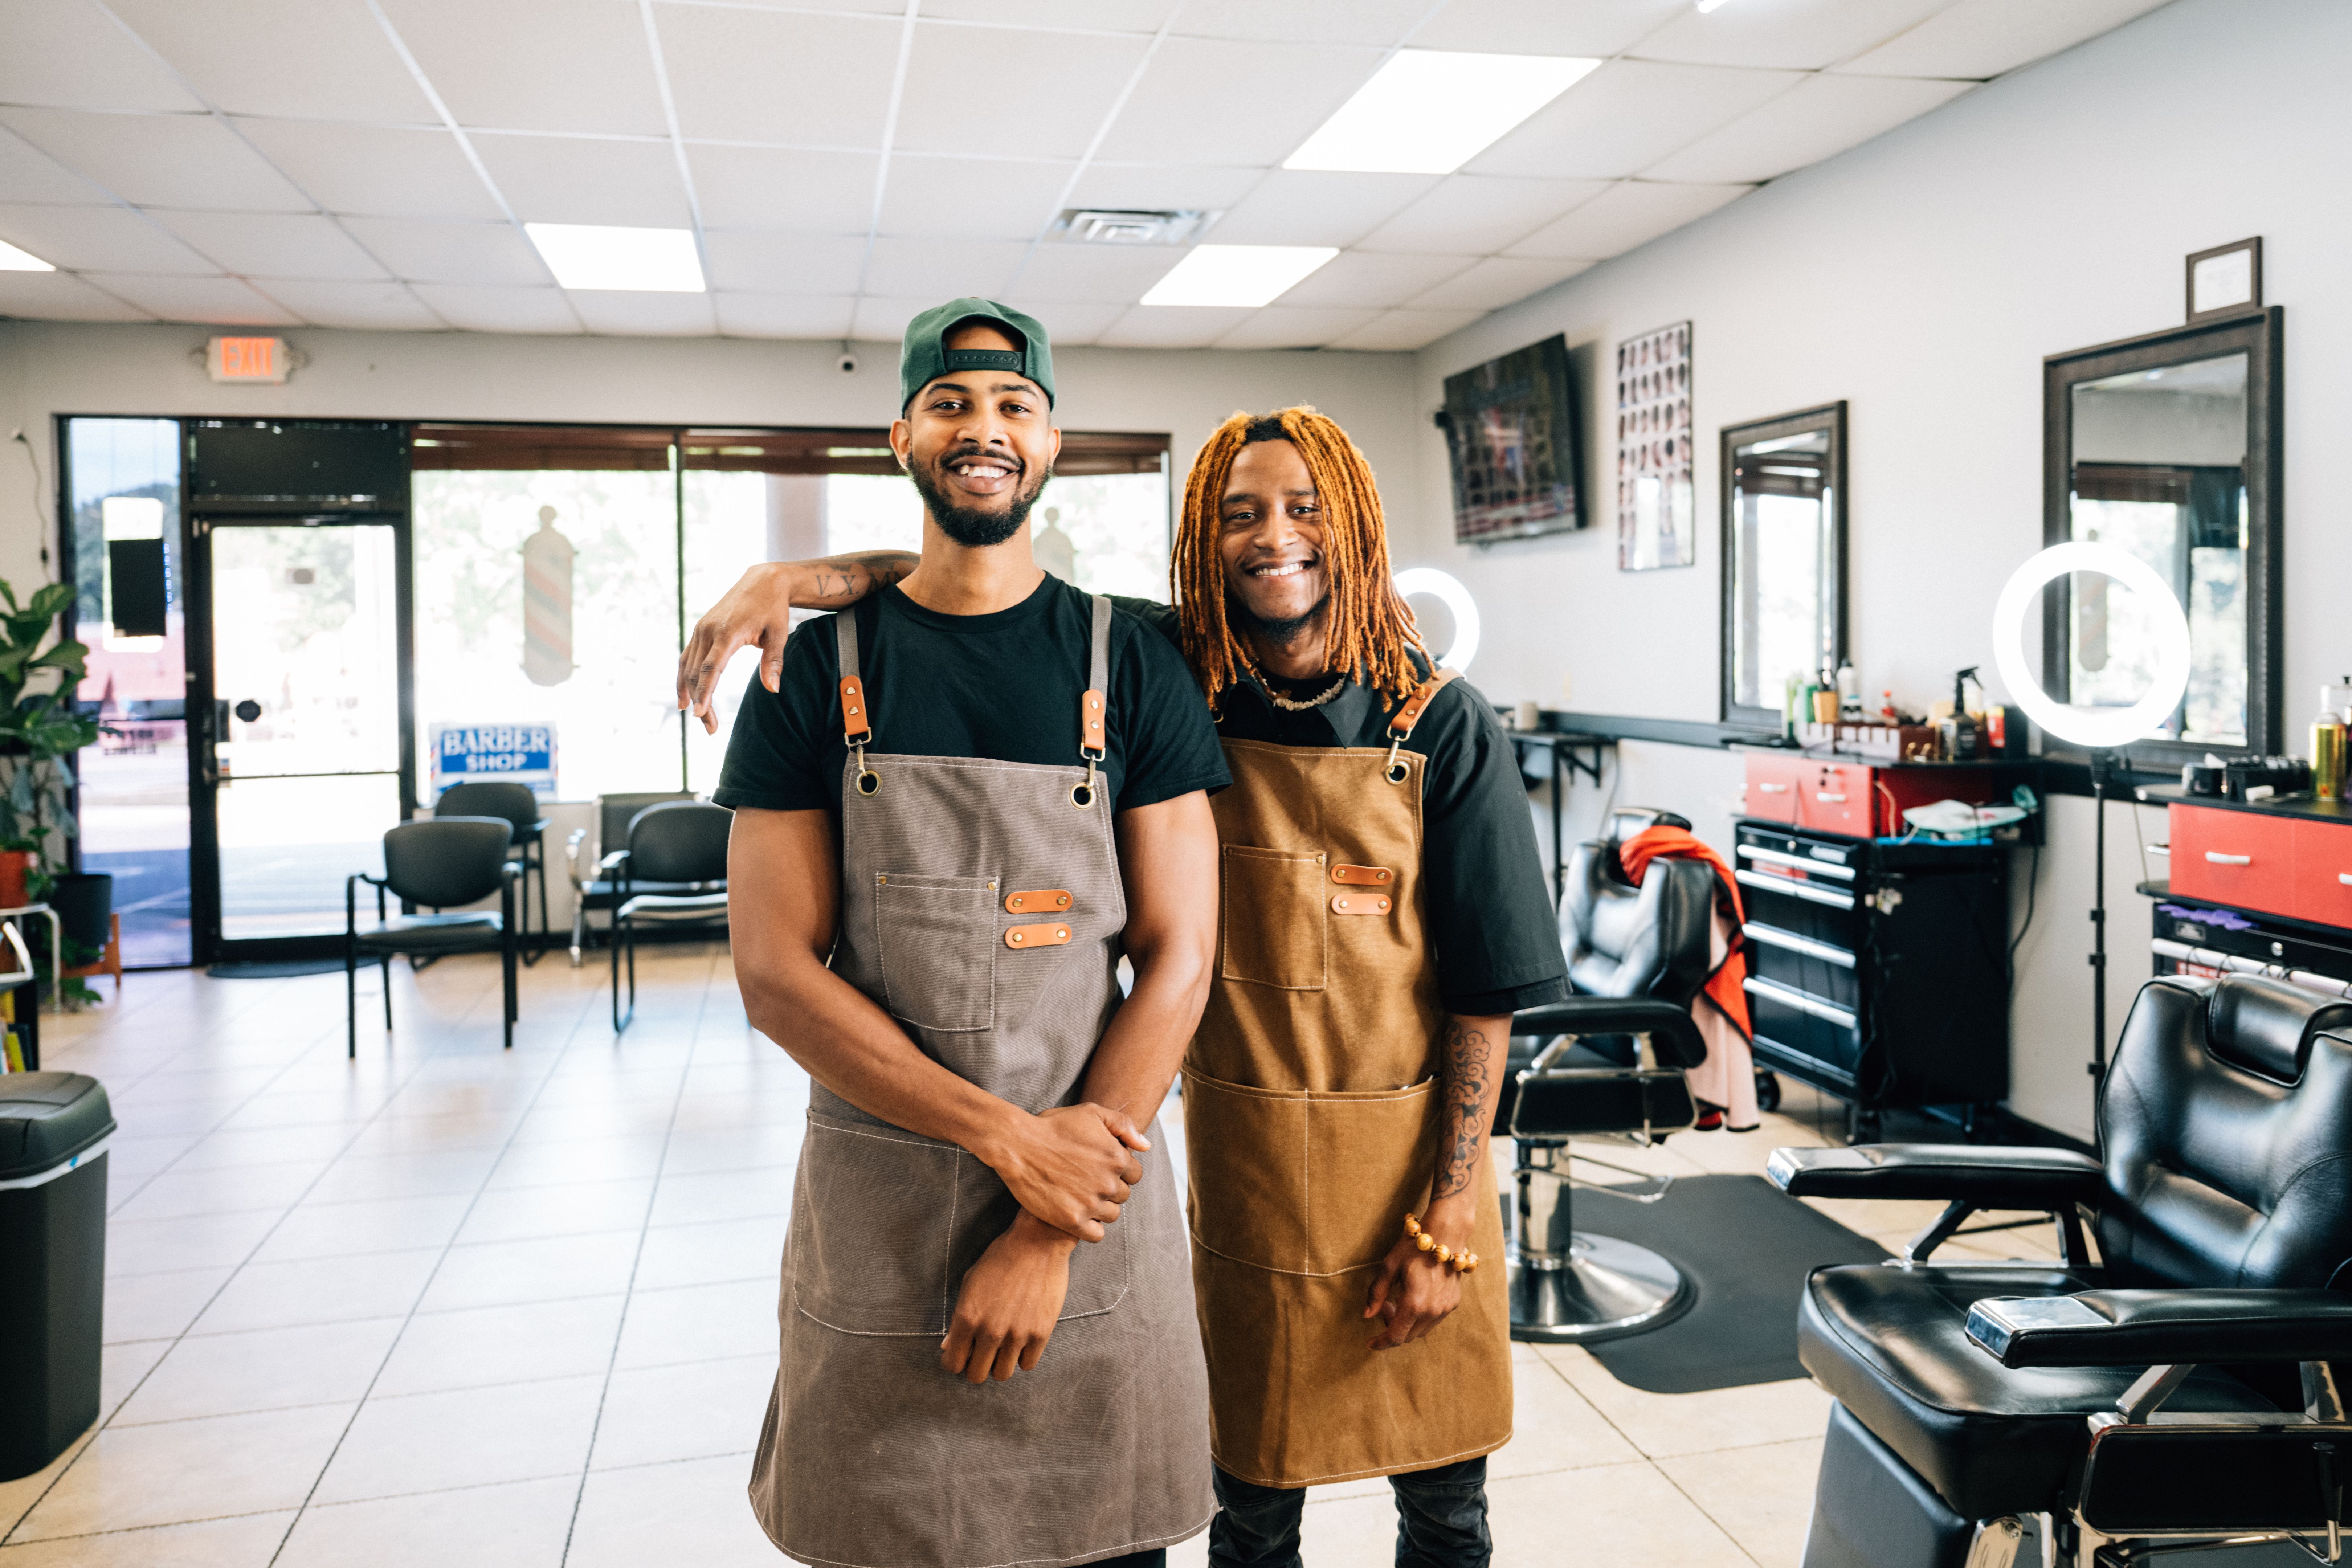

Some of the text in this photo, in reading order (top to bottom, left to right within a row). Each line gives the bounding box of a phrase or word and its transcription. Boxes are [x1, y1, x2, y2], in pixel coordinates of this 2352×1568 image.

[222, 338, 274, 376] EXIT
[444, 727, 548, 756] BARBER
[466, 752, 527, 771] SHOP
